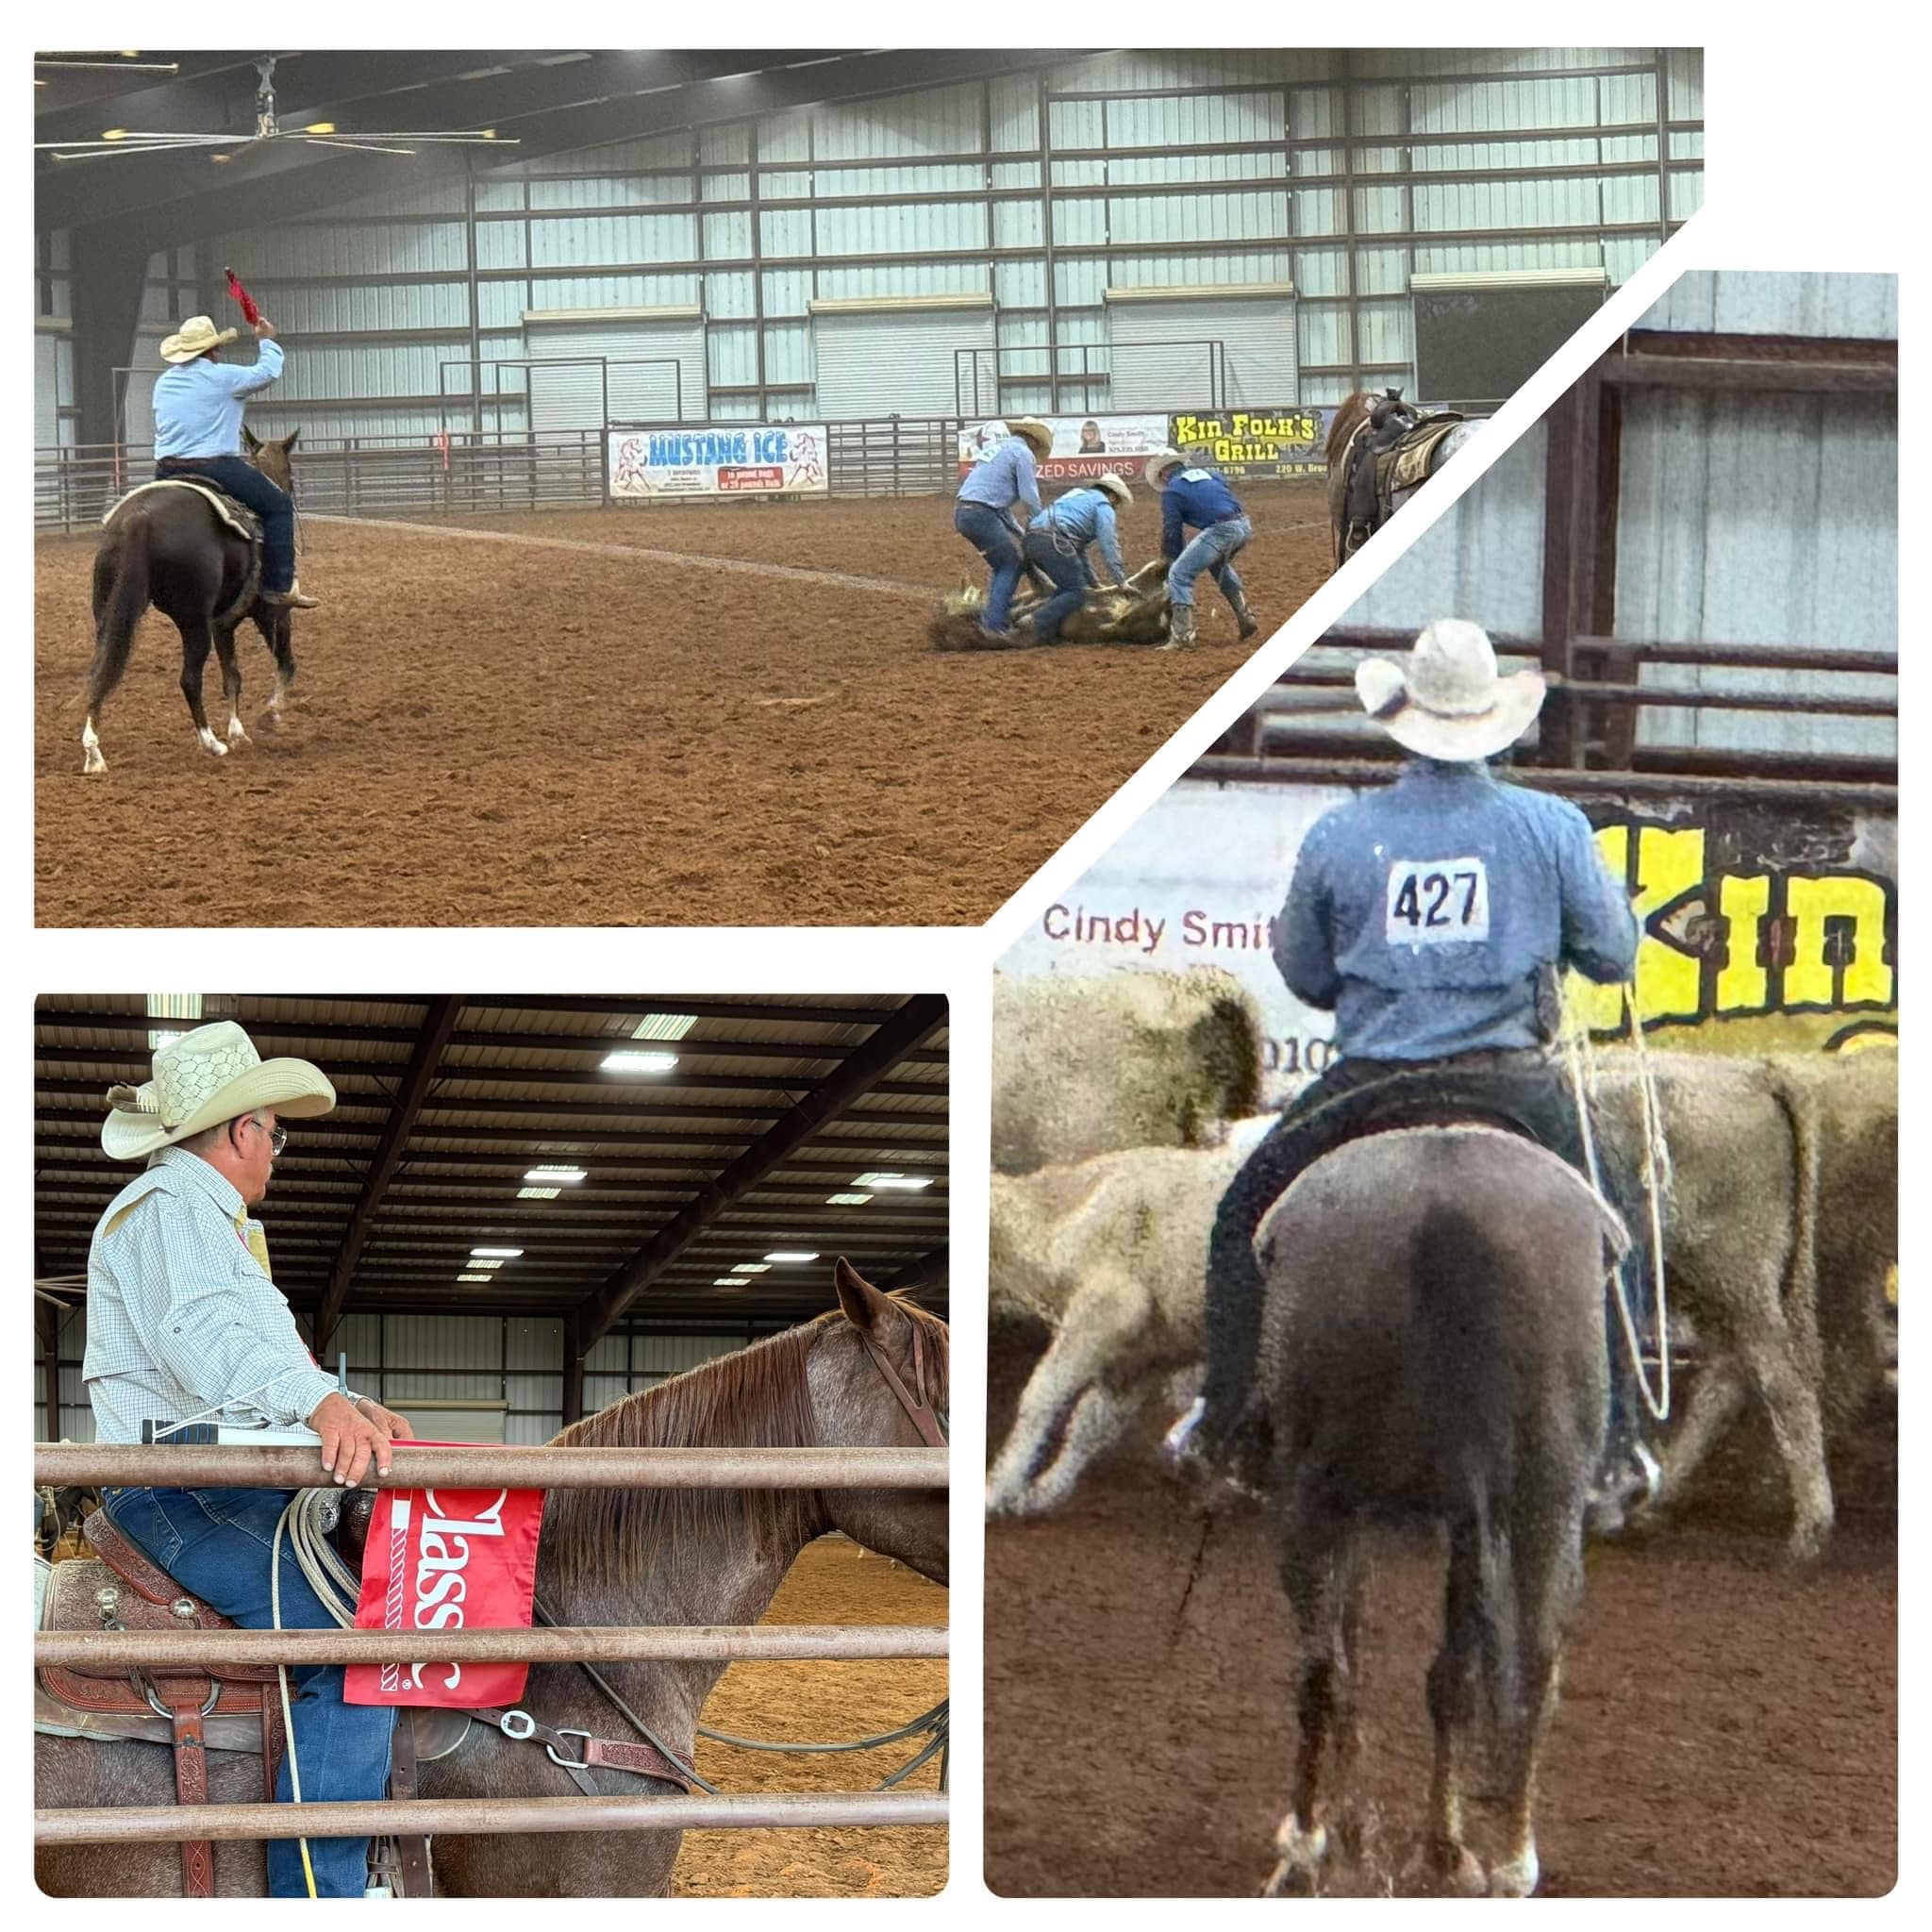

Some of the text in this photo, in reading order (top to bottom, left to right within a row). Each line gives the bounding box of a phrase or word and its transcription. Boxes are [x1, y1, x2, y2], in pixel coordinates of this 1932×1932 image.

[648, 430, 789, 467] MUSTANG ICE
[1175, 415, 1223, 445] Kin
[1213, 439, 1279, 462] GRILL
[1068, 461, 1135, 477] SAVINGS
[1392, 872, 1478, 927] 427
[1042, 903, 1166, 954] Cindy
[1561, 824, 1893, 1032] Kin
[411, 1488, 508, 1690] lassc
